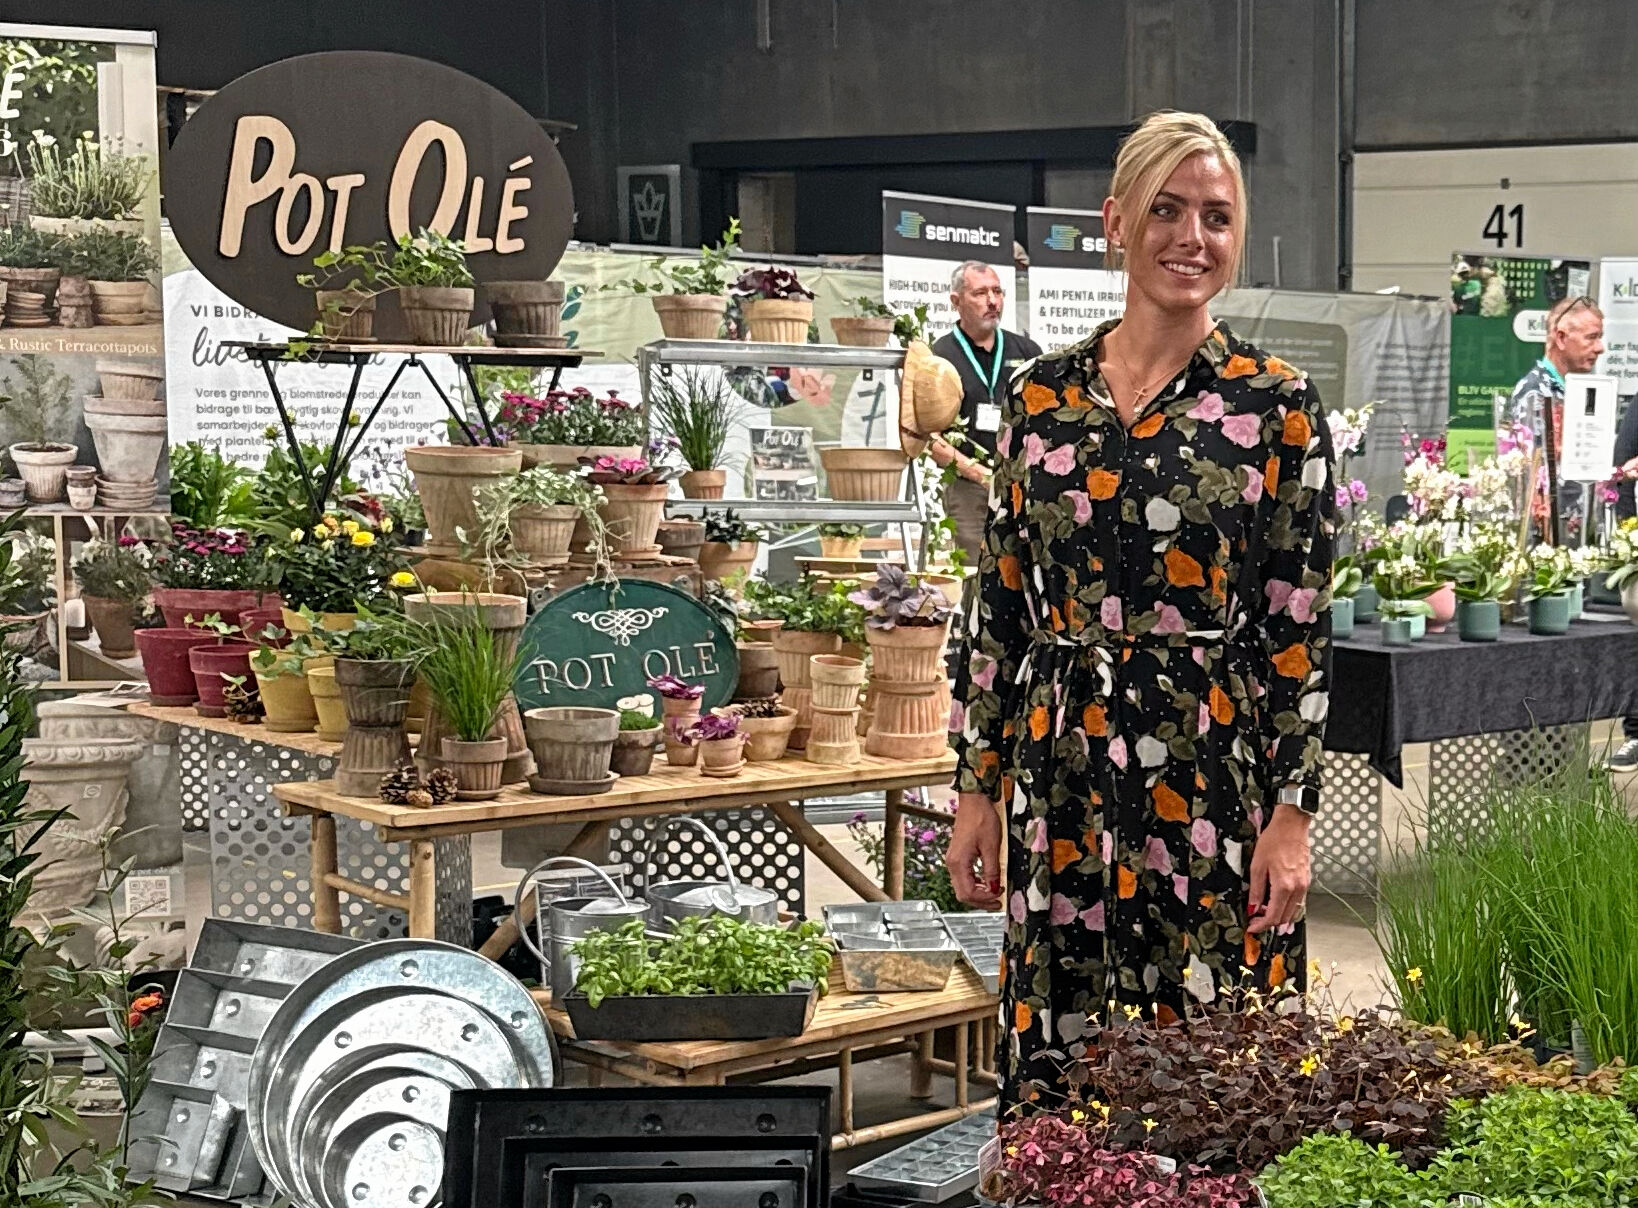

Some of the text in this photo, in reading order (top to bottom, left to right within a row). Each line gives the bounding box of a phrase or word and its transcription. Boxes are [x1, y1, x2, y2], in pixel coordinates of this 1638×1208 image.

[219, 115, 534, 258] POT OLÉ
[1482, 204, 1525, 248] 41
[925, 224, 1000, 247] senmatic
[931, 282, 951, 294] CLIM
[1039, 289, 1124, 302] AMI PENTA IRRIG
[190, 305, 259, 318] VI BIDR
[1039, 306, 1046, 317] &
[1050, 307, 1106, 318] FERTILIZER
[1046, 324, 1059, 335] To
[1061, 324, 1074, 335] be
[10, 338, 53, 351] Rustic
[55, 338, 157, 356] Terracottapots
[195, 388, 227, 399] Vores
[229, 389, 270, 401] grønne
[401, 390, 421, 399] kan
[196, 404, 240, 417] bidrage
[242, 404, 253, 414] til
[403, 404, 414, 415] Vi
[374, 422, 387, 433] og
[388, 420, 433, 433] bidrager
[531, 652, 617, 695] POT
